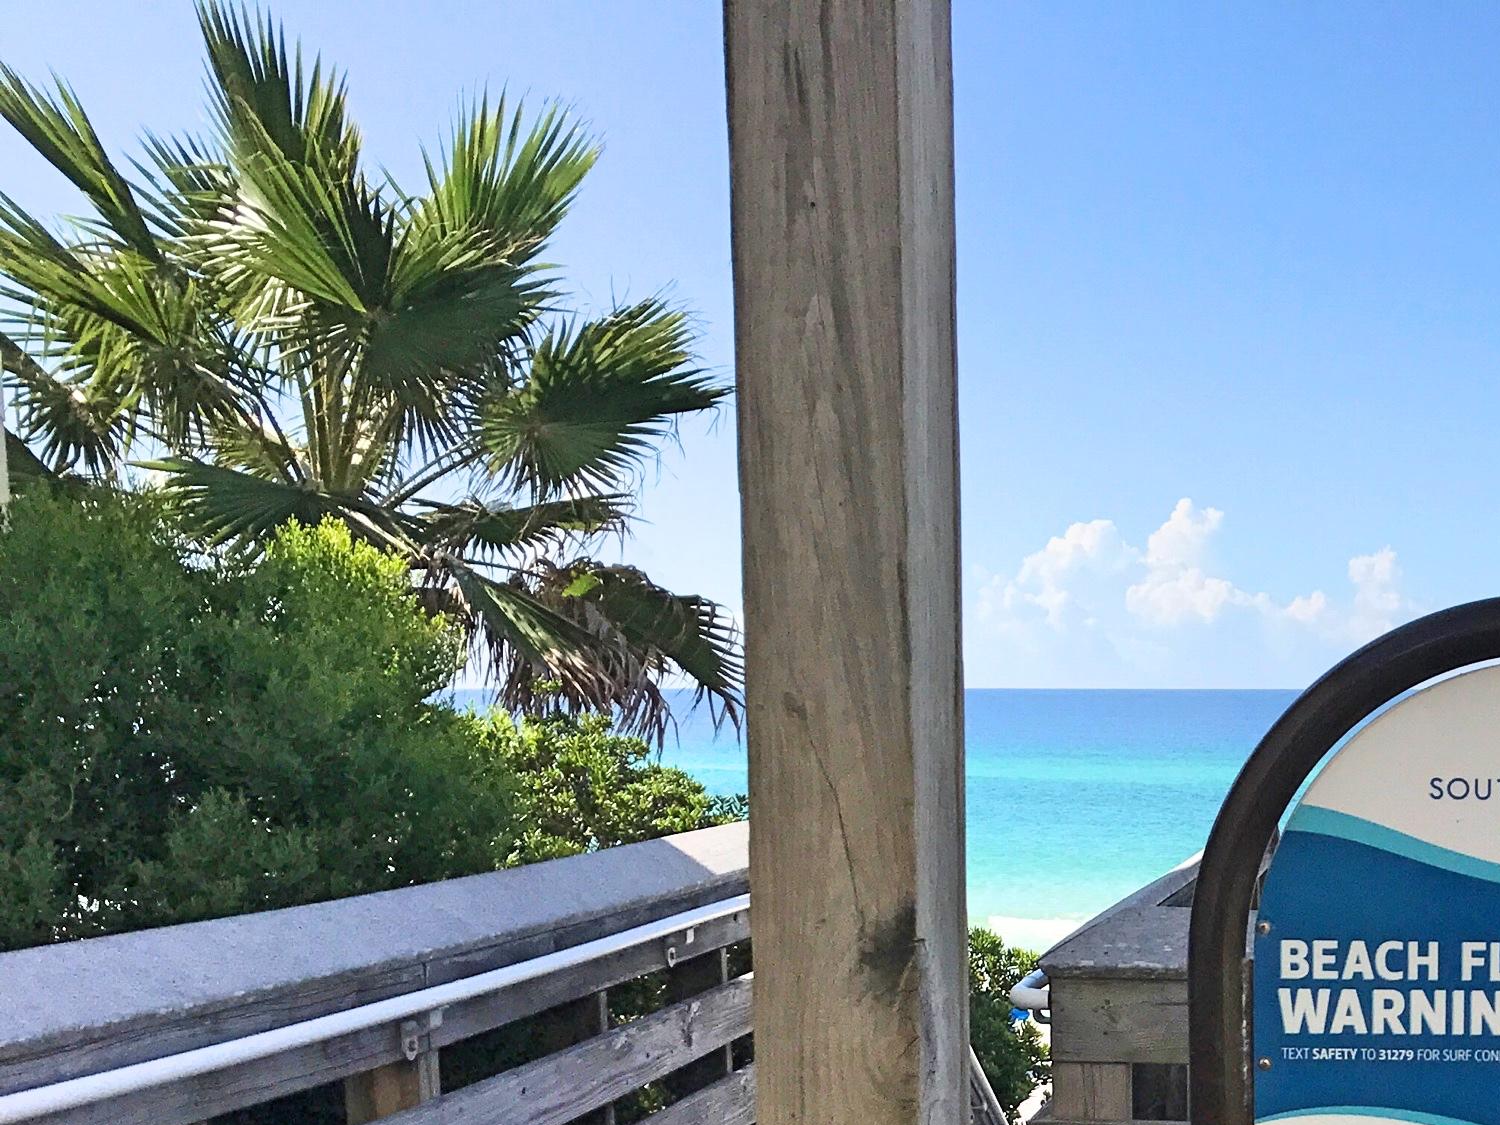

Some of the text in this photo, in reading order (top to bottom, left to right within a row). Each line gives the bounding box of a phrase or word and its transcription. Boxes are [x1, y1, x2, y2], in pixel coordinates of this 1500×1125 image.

[1280, 940, 1438, 980] BEACH
[1281, 1048, 1310, 1059] TEXT
[1312, 1048, 1357, 1060] SAFETY
[1360, 1049, 1376, 1060] TO
[1379, 1049, 1414, 1060] 31279
[1417, 1049, 1439, 1061] FOR
[1443, 1049, 1472, 1061] SURF
